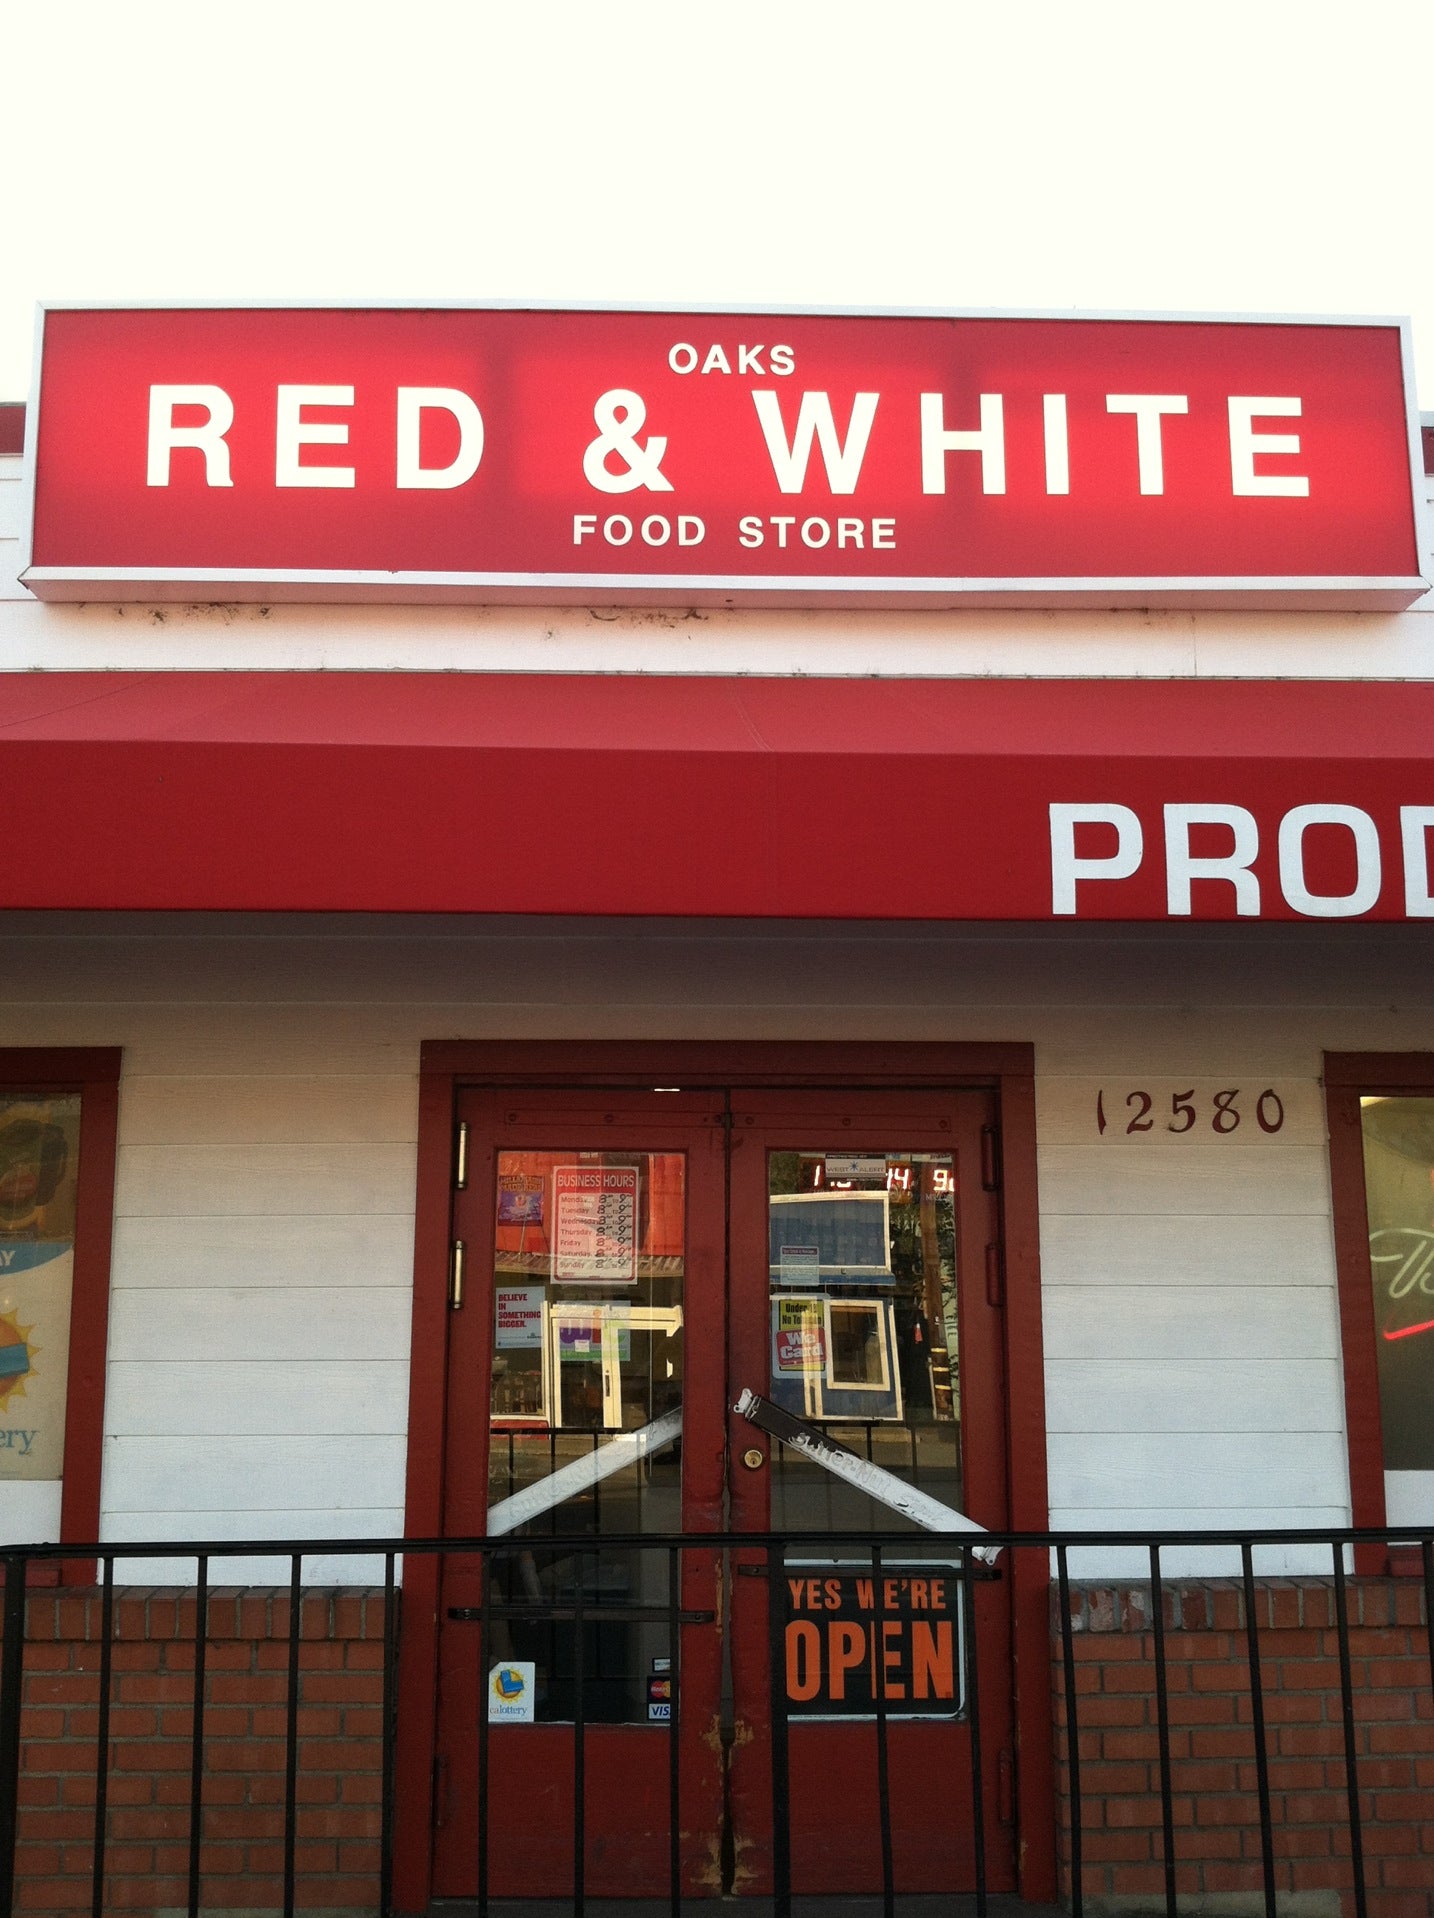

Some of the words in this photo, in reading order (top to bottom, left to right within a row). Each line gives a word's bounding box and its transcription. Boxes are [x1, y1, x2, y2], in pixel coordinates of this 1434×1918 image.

[668, 343, 796, 375] OAKS
[146, 384, 485, 489] RED
[582, 388, 675, 494] &
[752, 390, 1310, 497] WHITE
[572, 514, 706, 546] FOOD
[738, 516, 897, 549] STORE
[1097, 1088, 1285, 1136] 12580
[557, 1174, 600, 1187] BUSINESS
[603, 1174, 635, 1187] HOURS
[498, 1311, 541, 1319] SOMETHING
[786, 1303, 807, 1312] Under
[782, 1314, 791, 1324] No
[786, 1332, 816, 1346] We
[780, 1342, 824, 1359] Card
[788, 1578, 842, 1610] YES
[856, 1578, 946, 1610] WE'RE
[785, 1619, 954, 1702] OPEN
[490, 1705, 528, 1716] calottery
[651, 1706, 670, 1716] VIS
